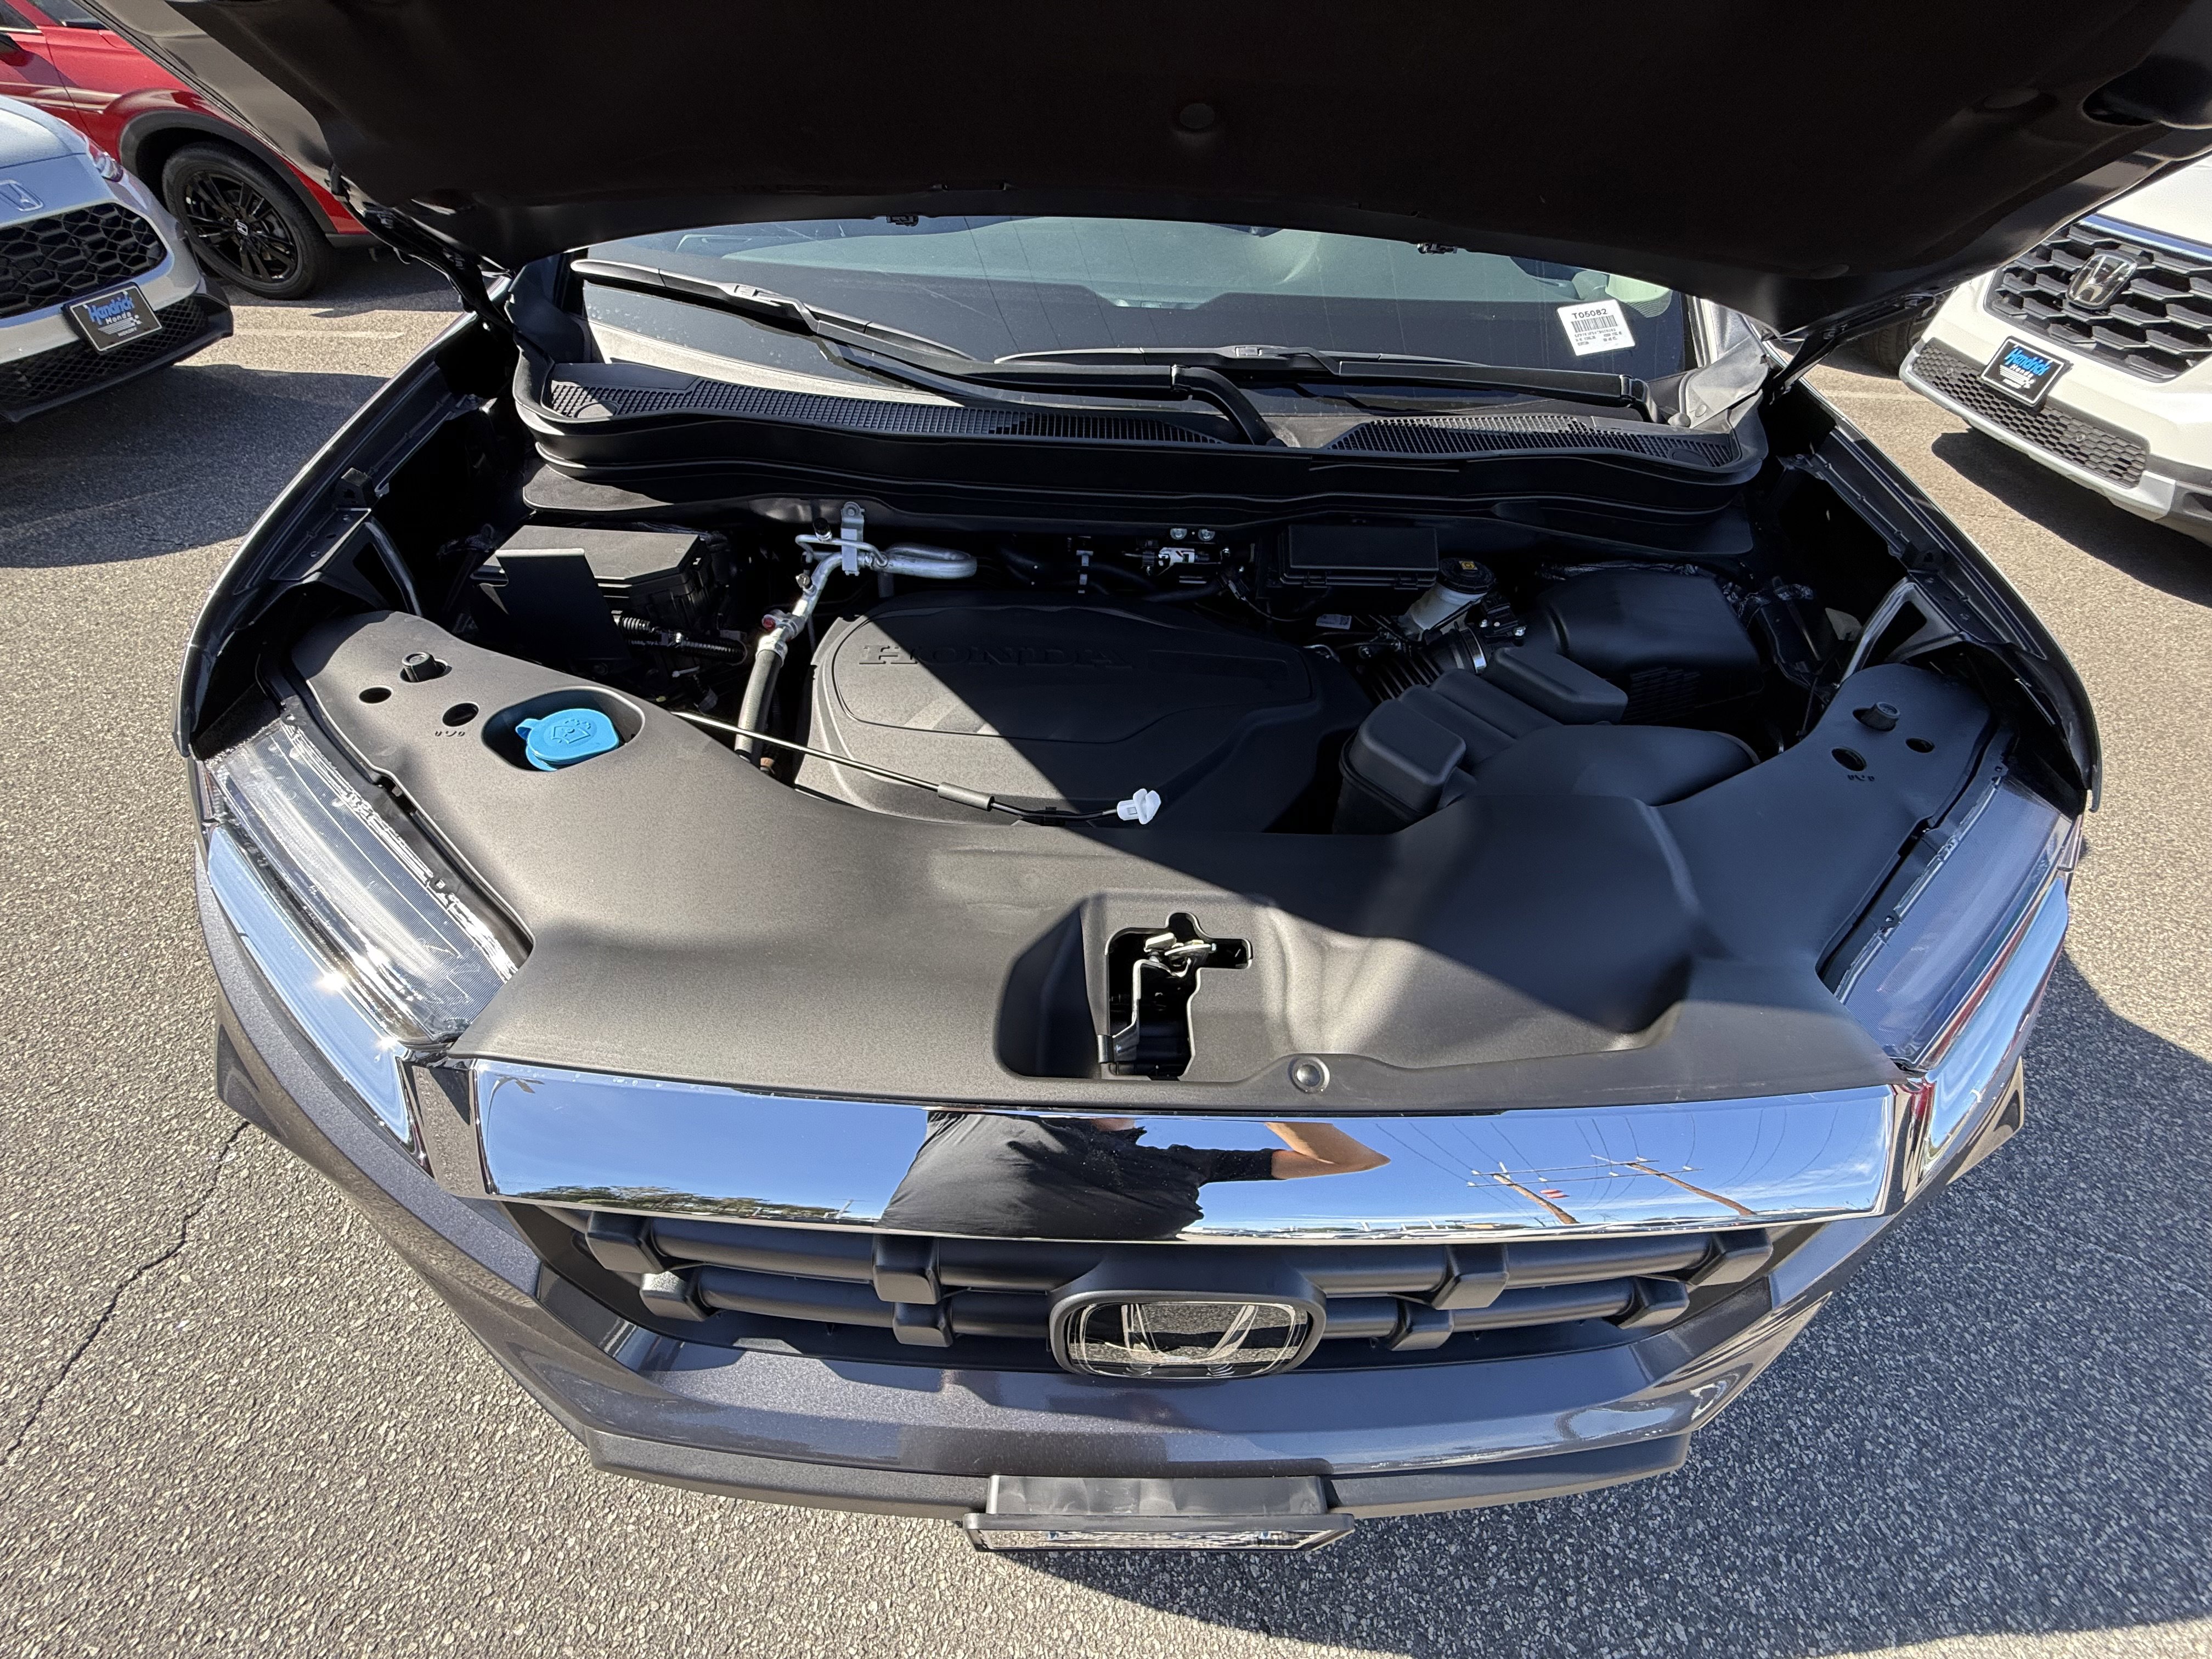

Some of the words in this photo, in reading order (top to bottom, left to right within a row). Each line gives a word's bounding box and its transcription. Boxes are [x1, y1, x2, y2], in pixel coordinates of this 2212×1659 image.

[105, 311, 132, 325] Honda
[1572, 308, 1608, 319] T05082
[2009, 364, 2034, 378] Honda
[859, 645, 1133, 669] HONDA
